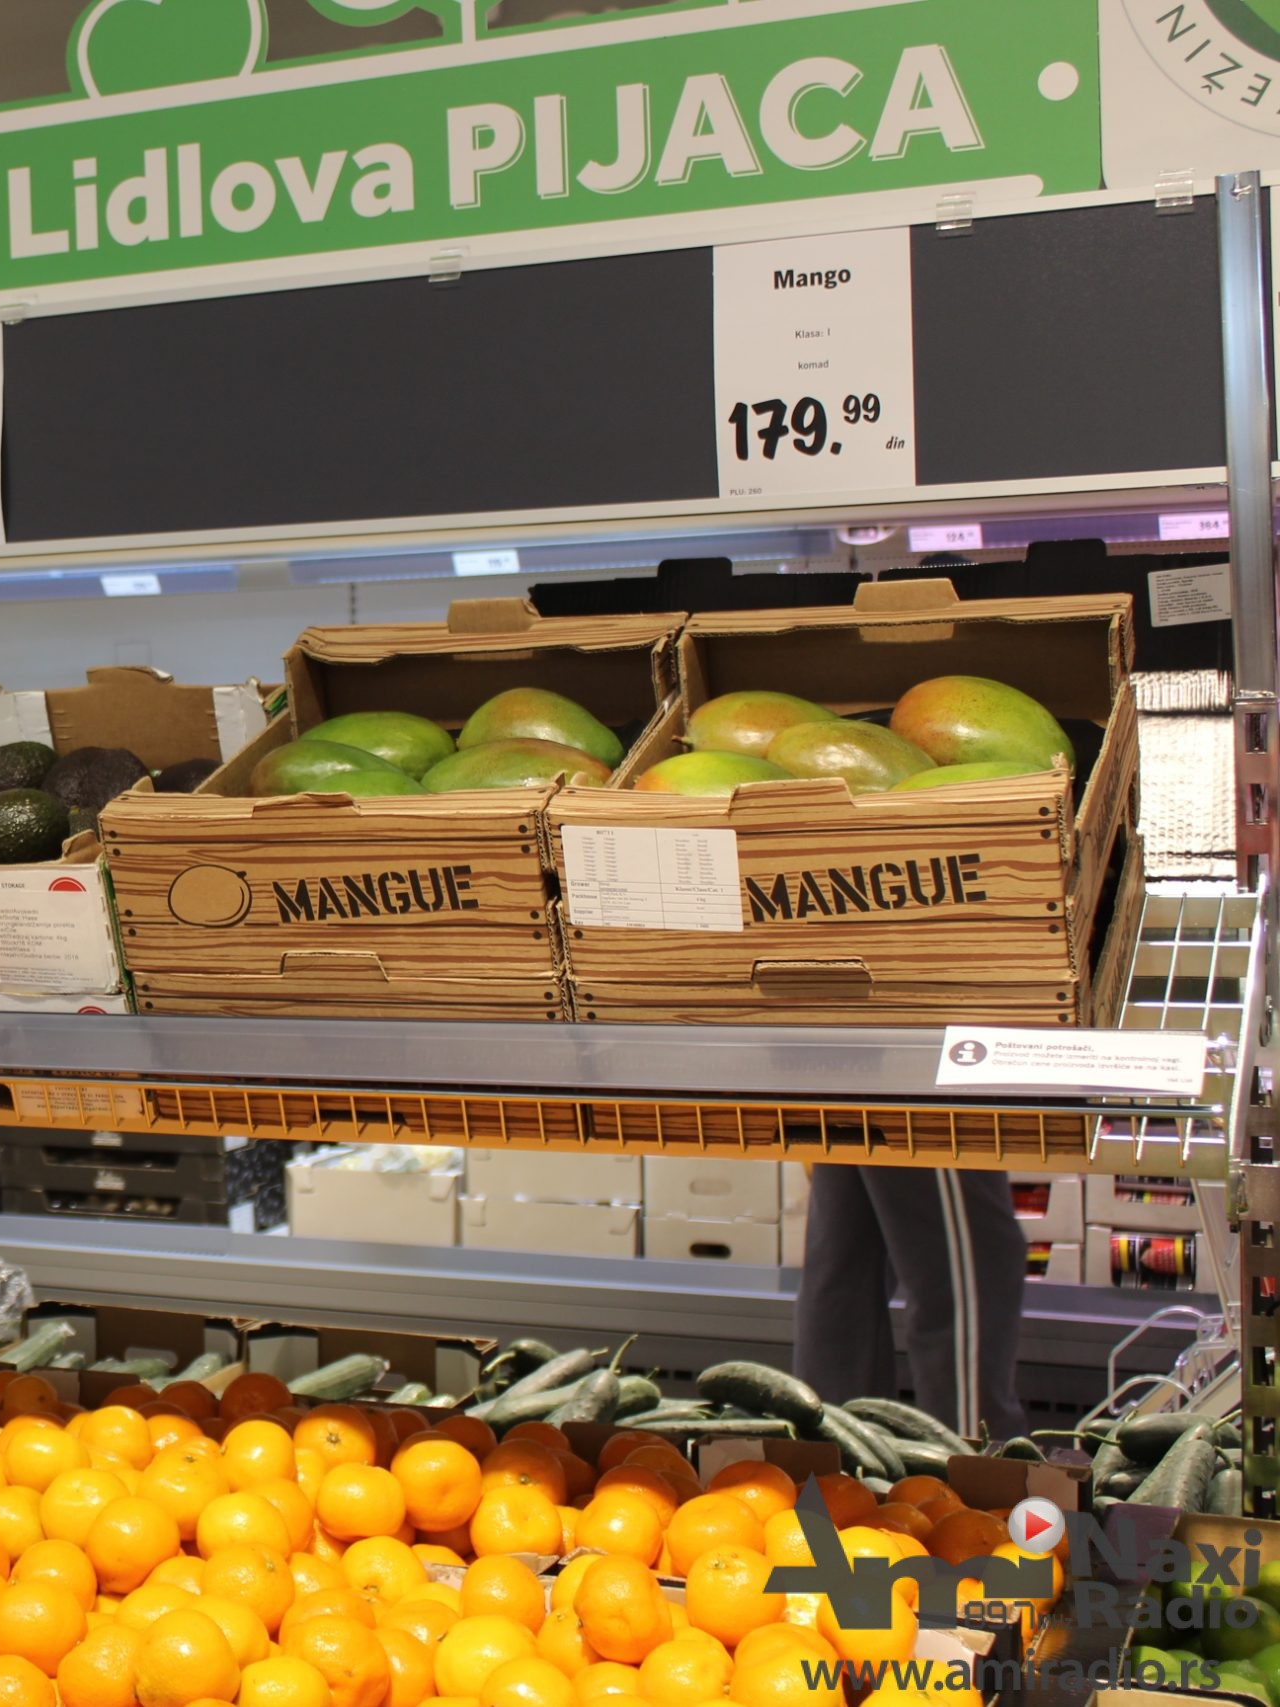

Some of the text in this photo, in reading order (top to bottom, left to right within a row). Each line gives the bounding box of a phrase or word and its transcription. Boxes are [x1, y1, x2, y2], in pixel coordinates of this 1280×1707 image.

[7, 43, 986, 260] Lidlova PIJACA
[773, 267, 852, 290] Mango
[795, 329, 824, 339] Klasa:
[797, 360, 830, 370] komad
[728, 393, 906, 461] 179. 99 din
[271, 864, 480, 924] MANGUE
[744, 853, 988, 923] MANGUE
